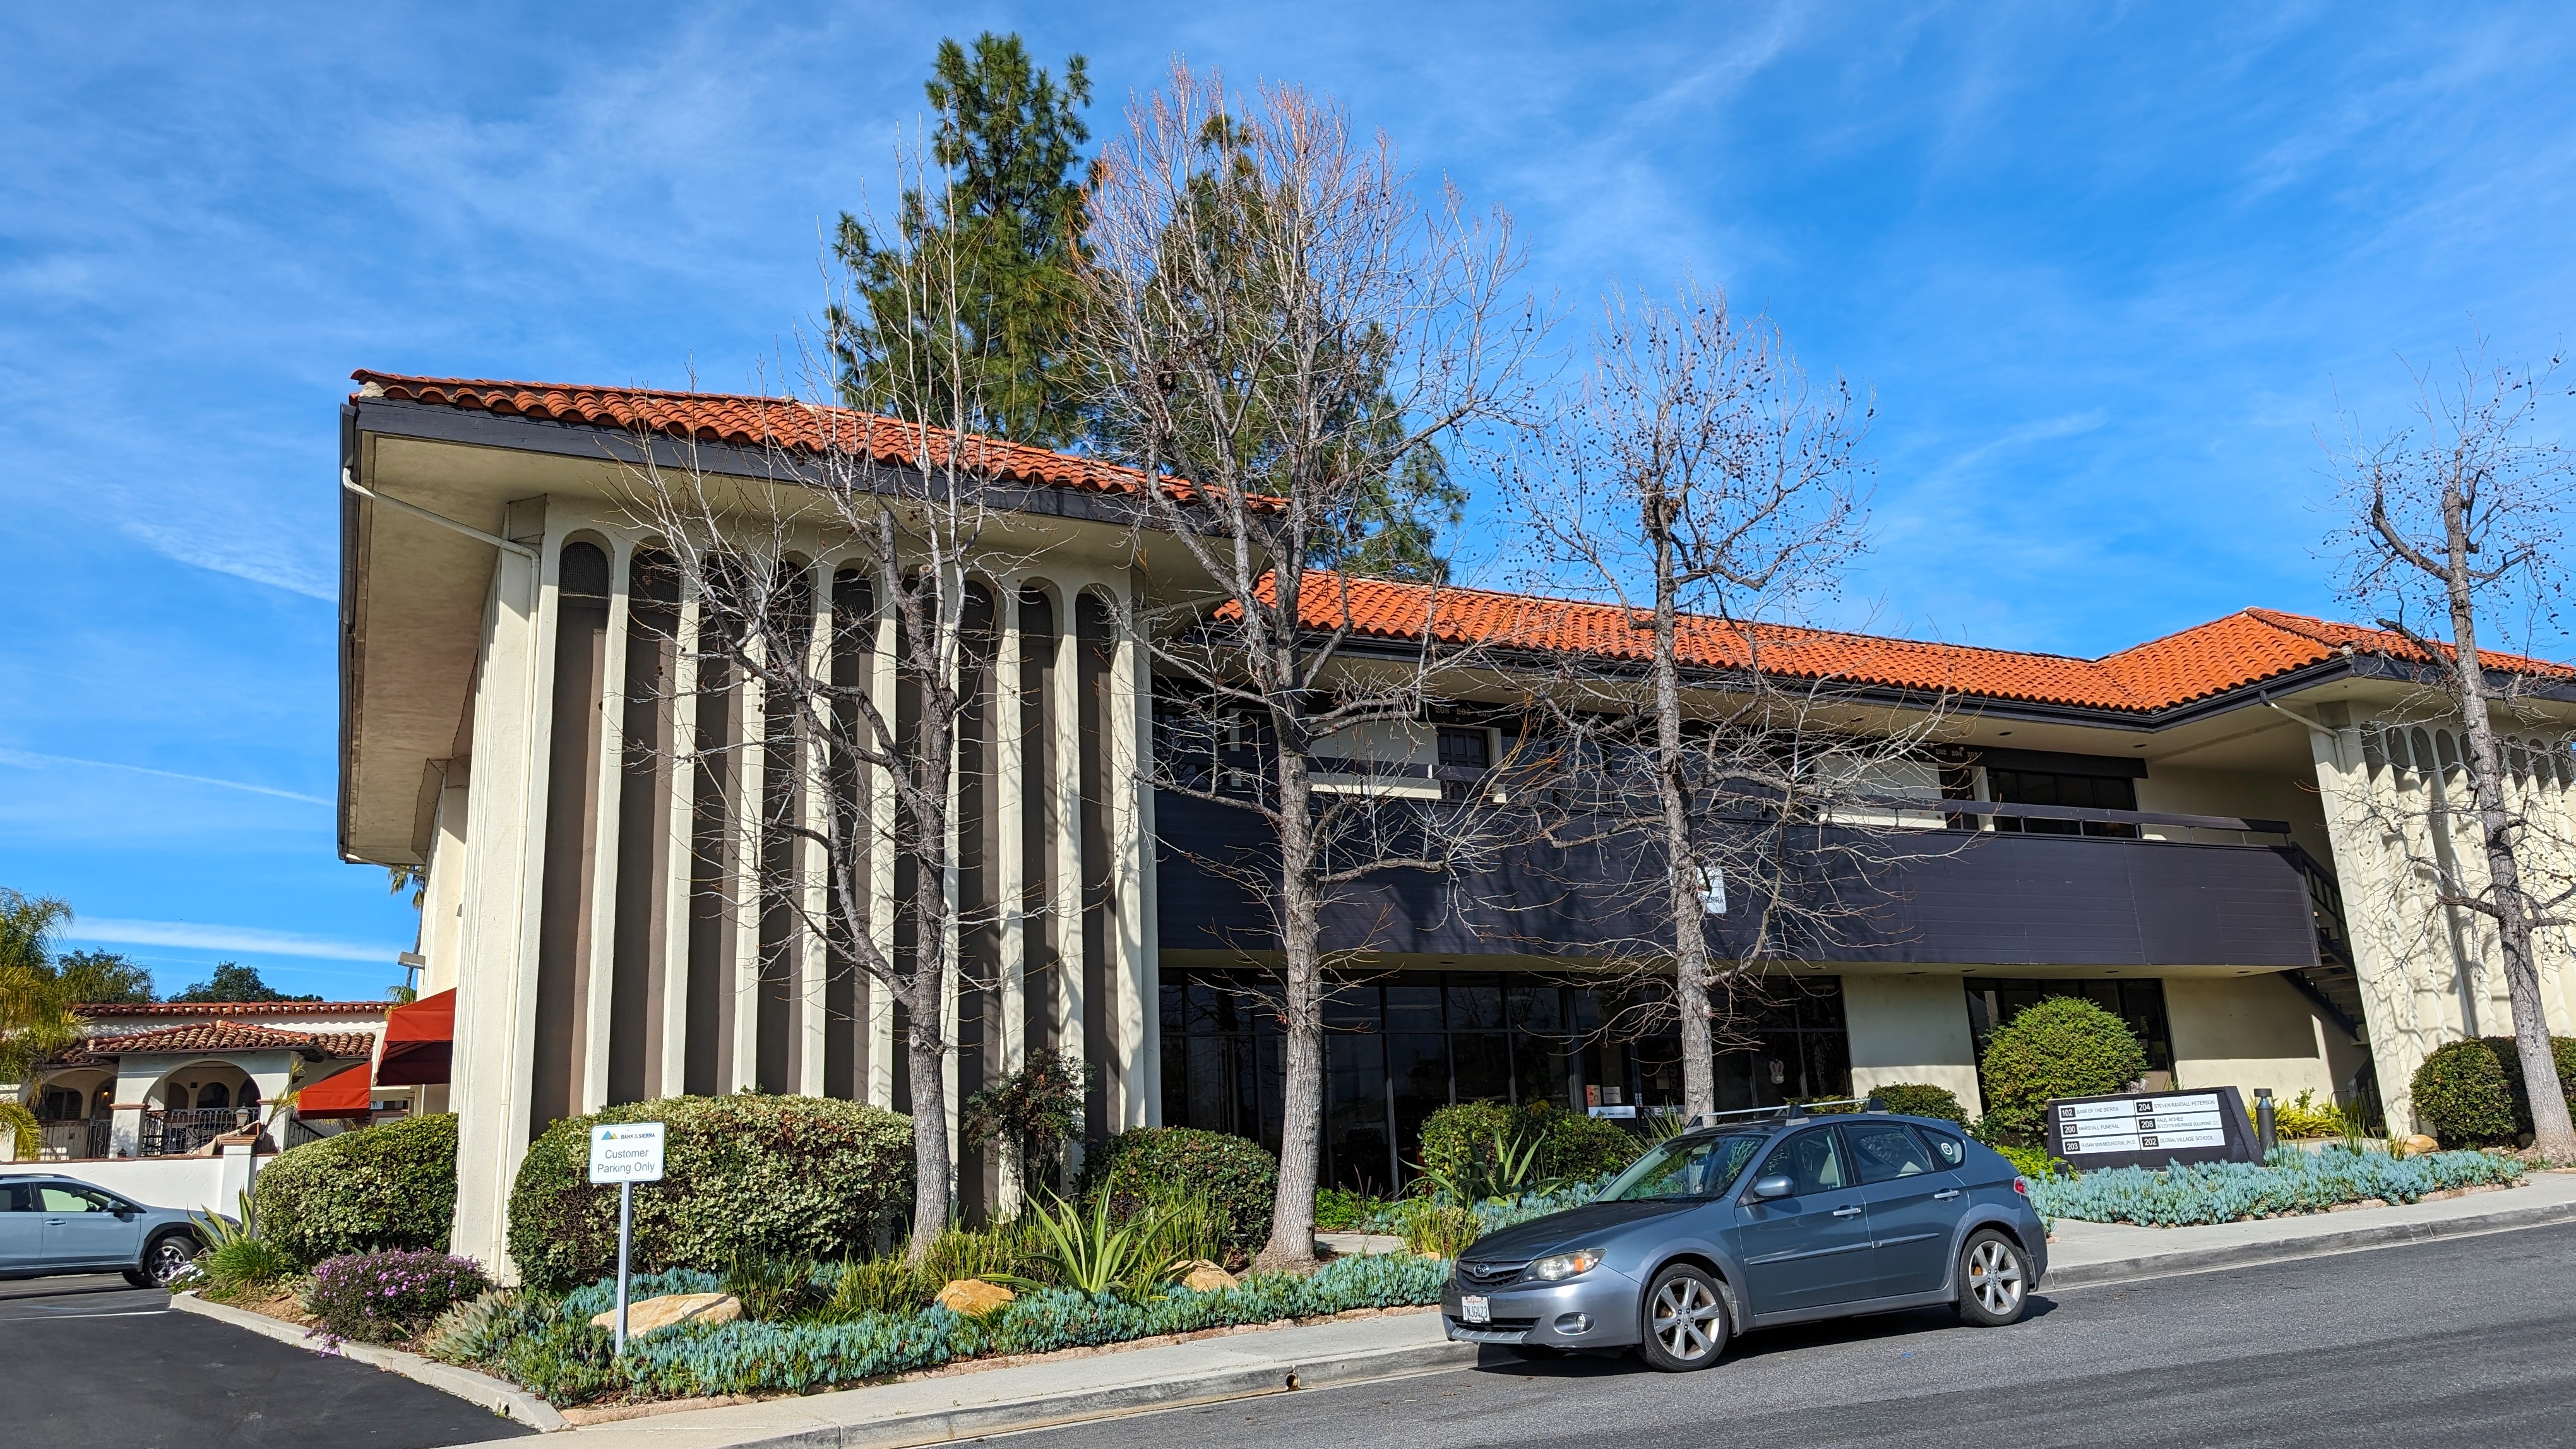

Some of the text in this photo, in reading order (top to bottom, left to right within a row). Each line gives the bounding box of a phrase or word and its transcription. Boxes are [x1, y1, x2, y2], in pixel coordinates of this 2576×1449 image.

[605, 1149, 649, 1159] Customer
[597, 1162, 655, 1174] Parking Only
[1463, 1305, 1488, 1318] 7NJG423
